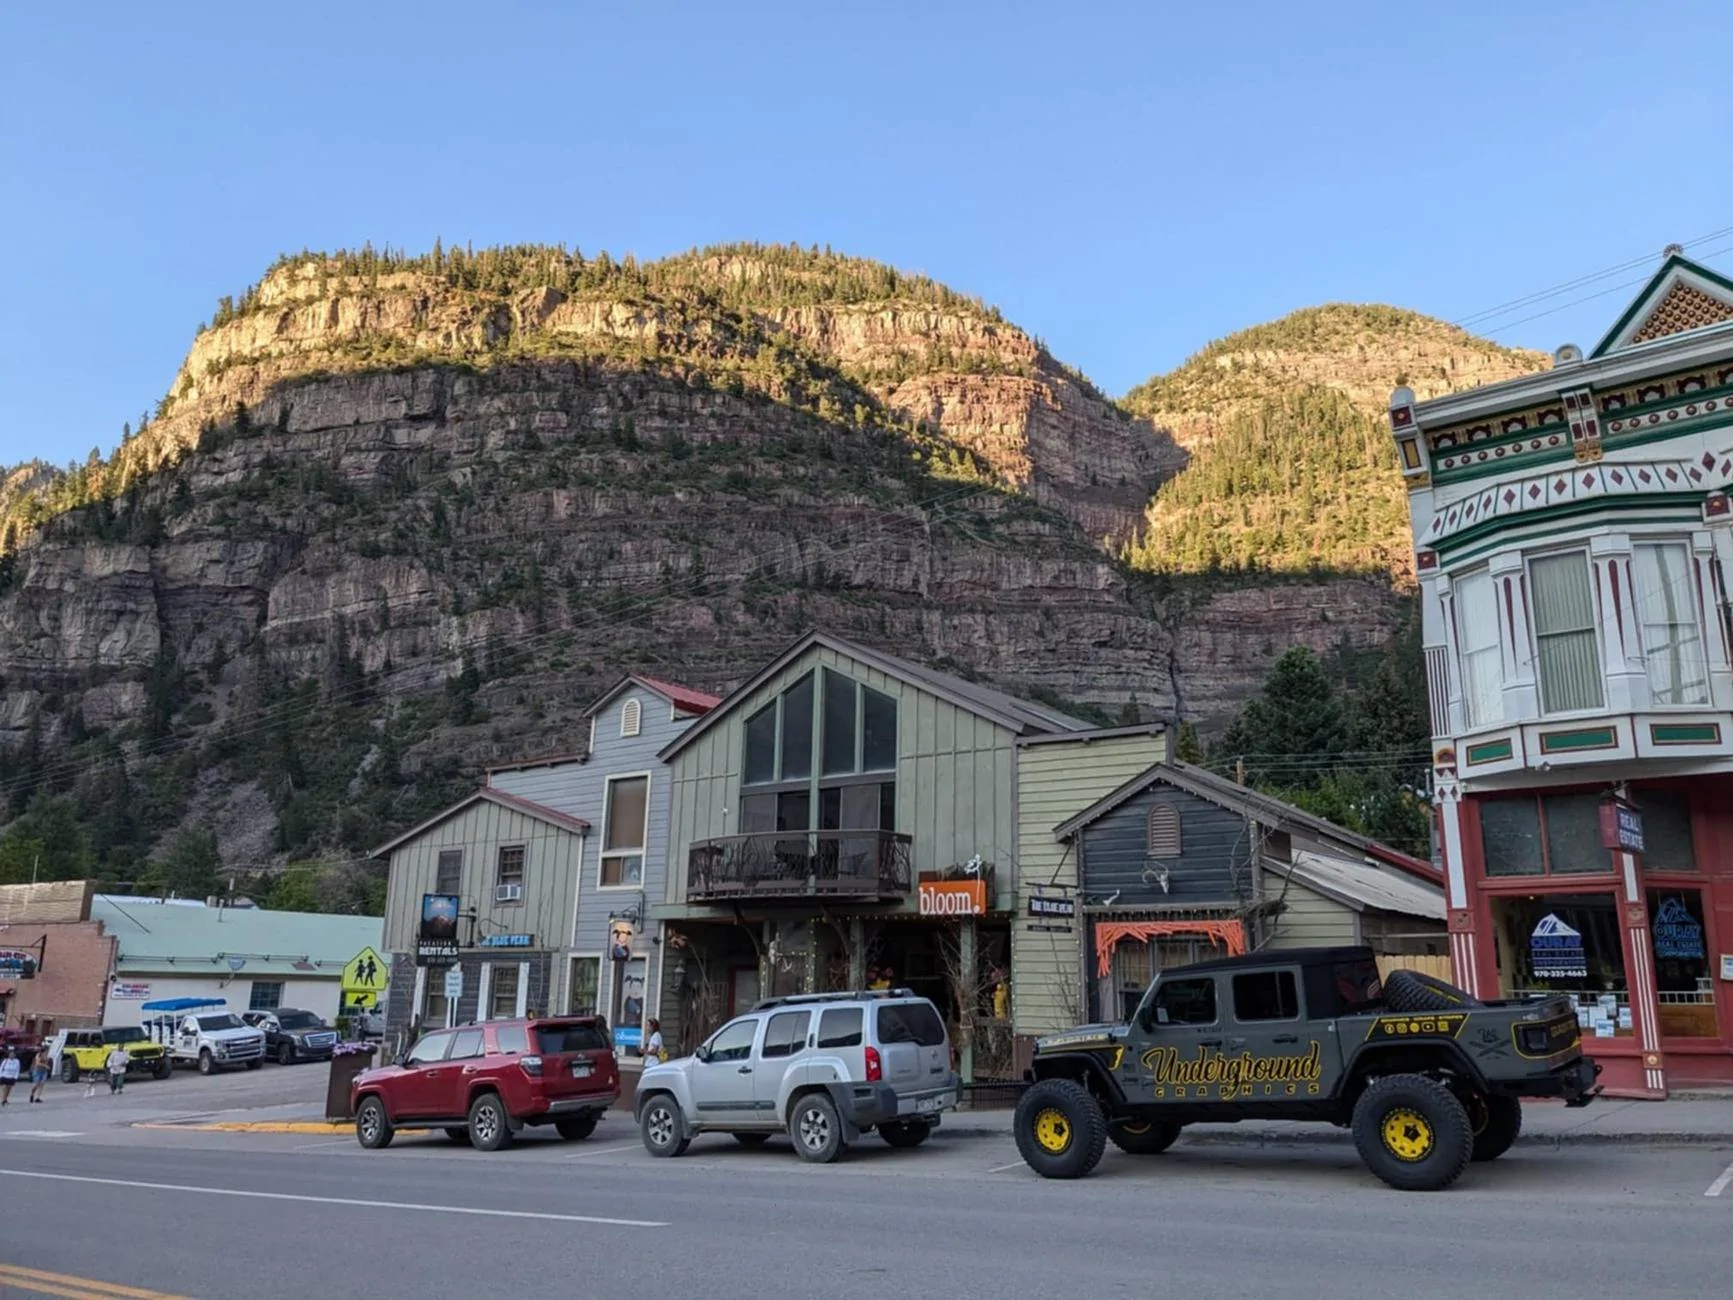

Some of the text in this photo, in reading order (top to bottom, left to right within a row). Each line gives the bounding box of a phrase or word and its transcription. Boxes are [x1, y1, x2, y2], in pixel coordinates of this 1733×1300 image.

[1619, 829, 1644, 850] ESTATE
[419, 946, 458, 955] RENTALS
[1141, 1040, 1322, 1099] Underground
[1155, 1083, 1320, 1098] GRAPHICS
